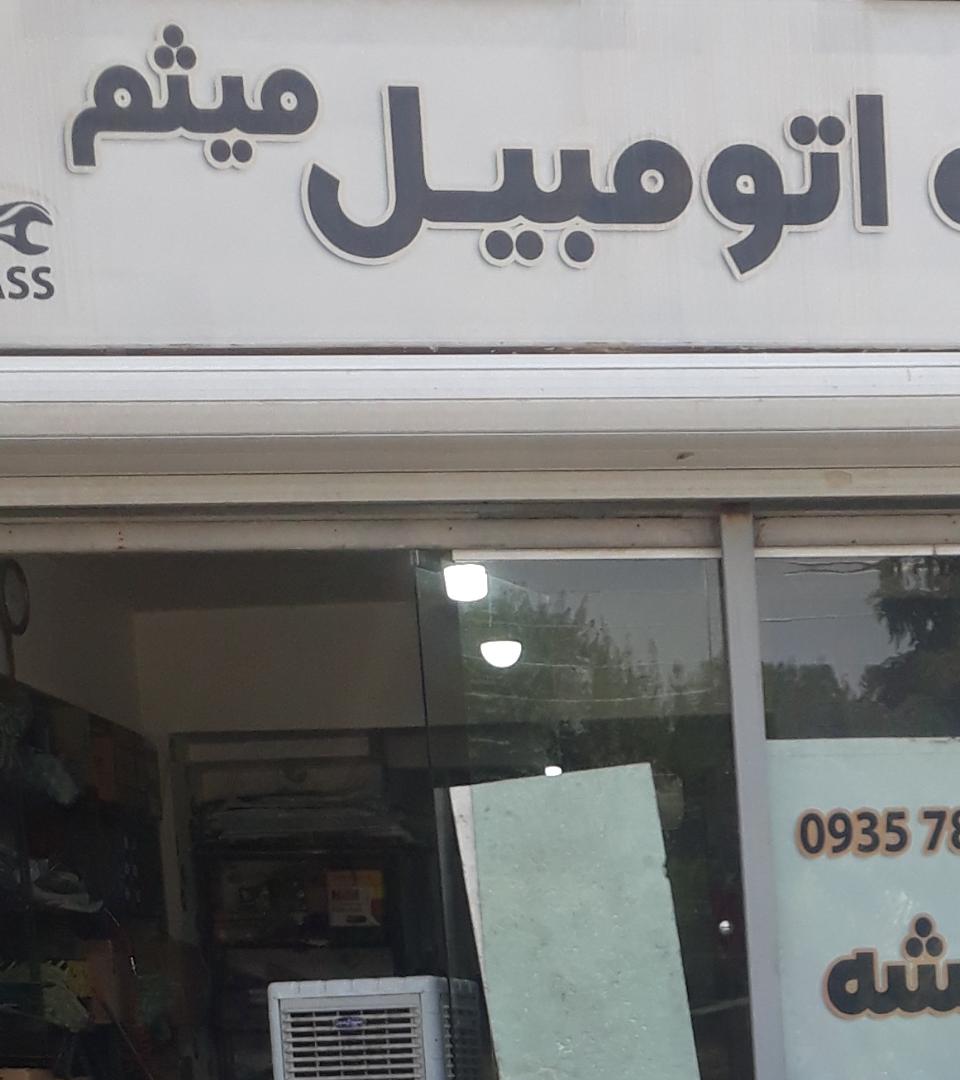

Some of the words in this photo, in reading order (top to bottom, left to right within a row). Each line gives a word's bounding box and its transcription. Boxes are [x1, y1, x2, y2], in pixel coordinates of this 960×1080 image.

[70, 24, 320, 168] میثم
[306, 85, 890, 276] اتومبیل
[0, 266, 55, 300] SS
[799, 810, 909, 855] 0935
